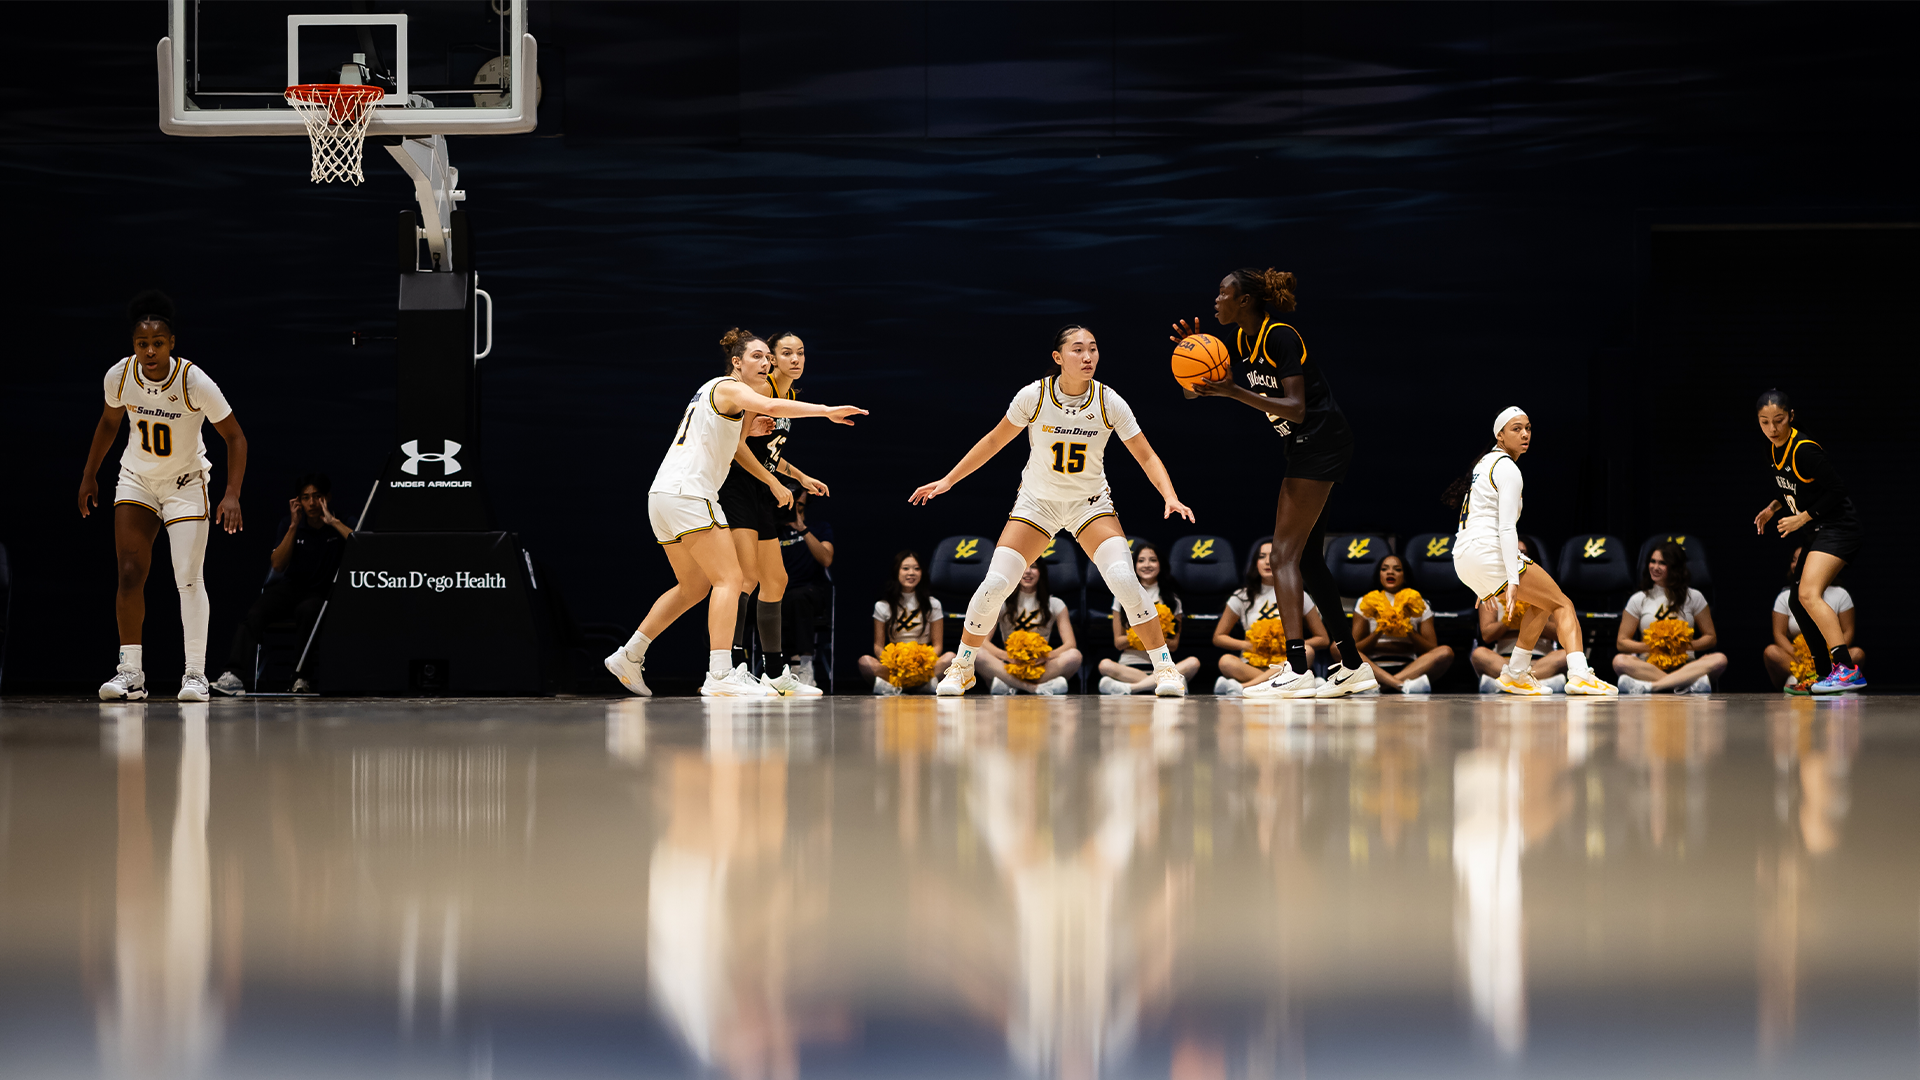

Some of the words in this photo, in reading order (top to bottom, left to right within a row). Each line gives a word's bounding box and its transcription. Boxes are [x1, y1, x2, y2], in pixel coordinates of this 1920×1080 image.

[136, 418, 172, 458] 10
[766, 434, 787, 463] 42
[1050, 440, 1088, 474] 15
[350, 570, 376, 588] UC
[377, 570, 408, 588] San
[409, 571, 454, 592] Dego
[455, 571, 507, 588] Health
